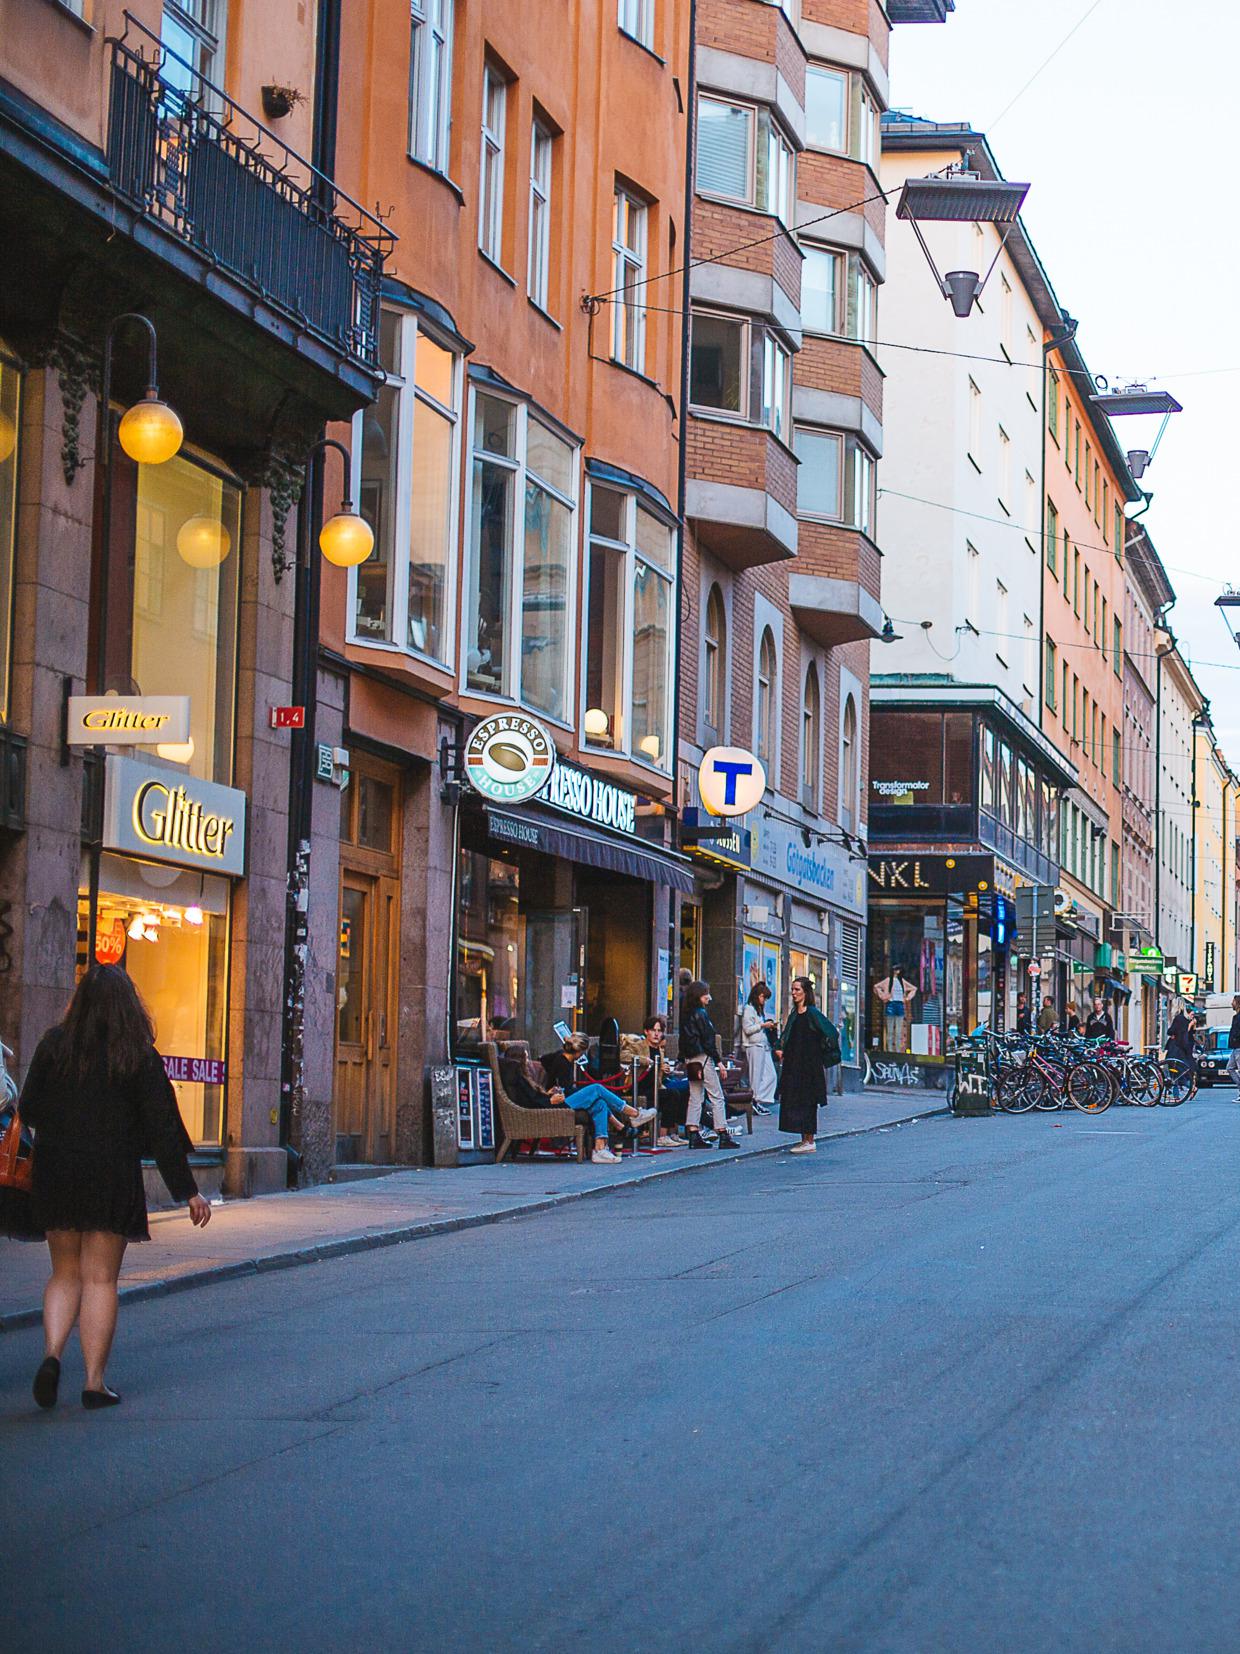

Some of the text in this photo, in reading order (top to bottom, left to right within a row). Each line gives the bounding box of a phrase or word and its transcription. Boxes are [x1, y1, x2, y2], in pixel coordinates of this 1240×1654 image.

[82, 706, 169, 730] Glitter
[472, 717, 546, 751] ESPRESSO
[477, 774, 536, 796] HOUSE
[535, 762, 592, 816] RESSO
[713, 760, 753, 805] T
[132, 780, 234, 858] Glitter
[592, 779, 636, 833] HOUSE
[192, 1058, 218, 1083] SALE
